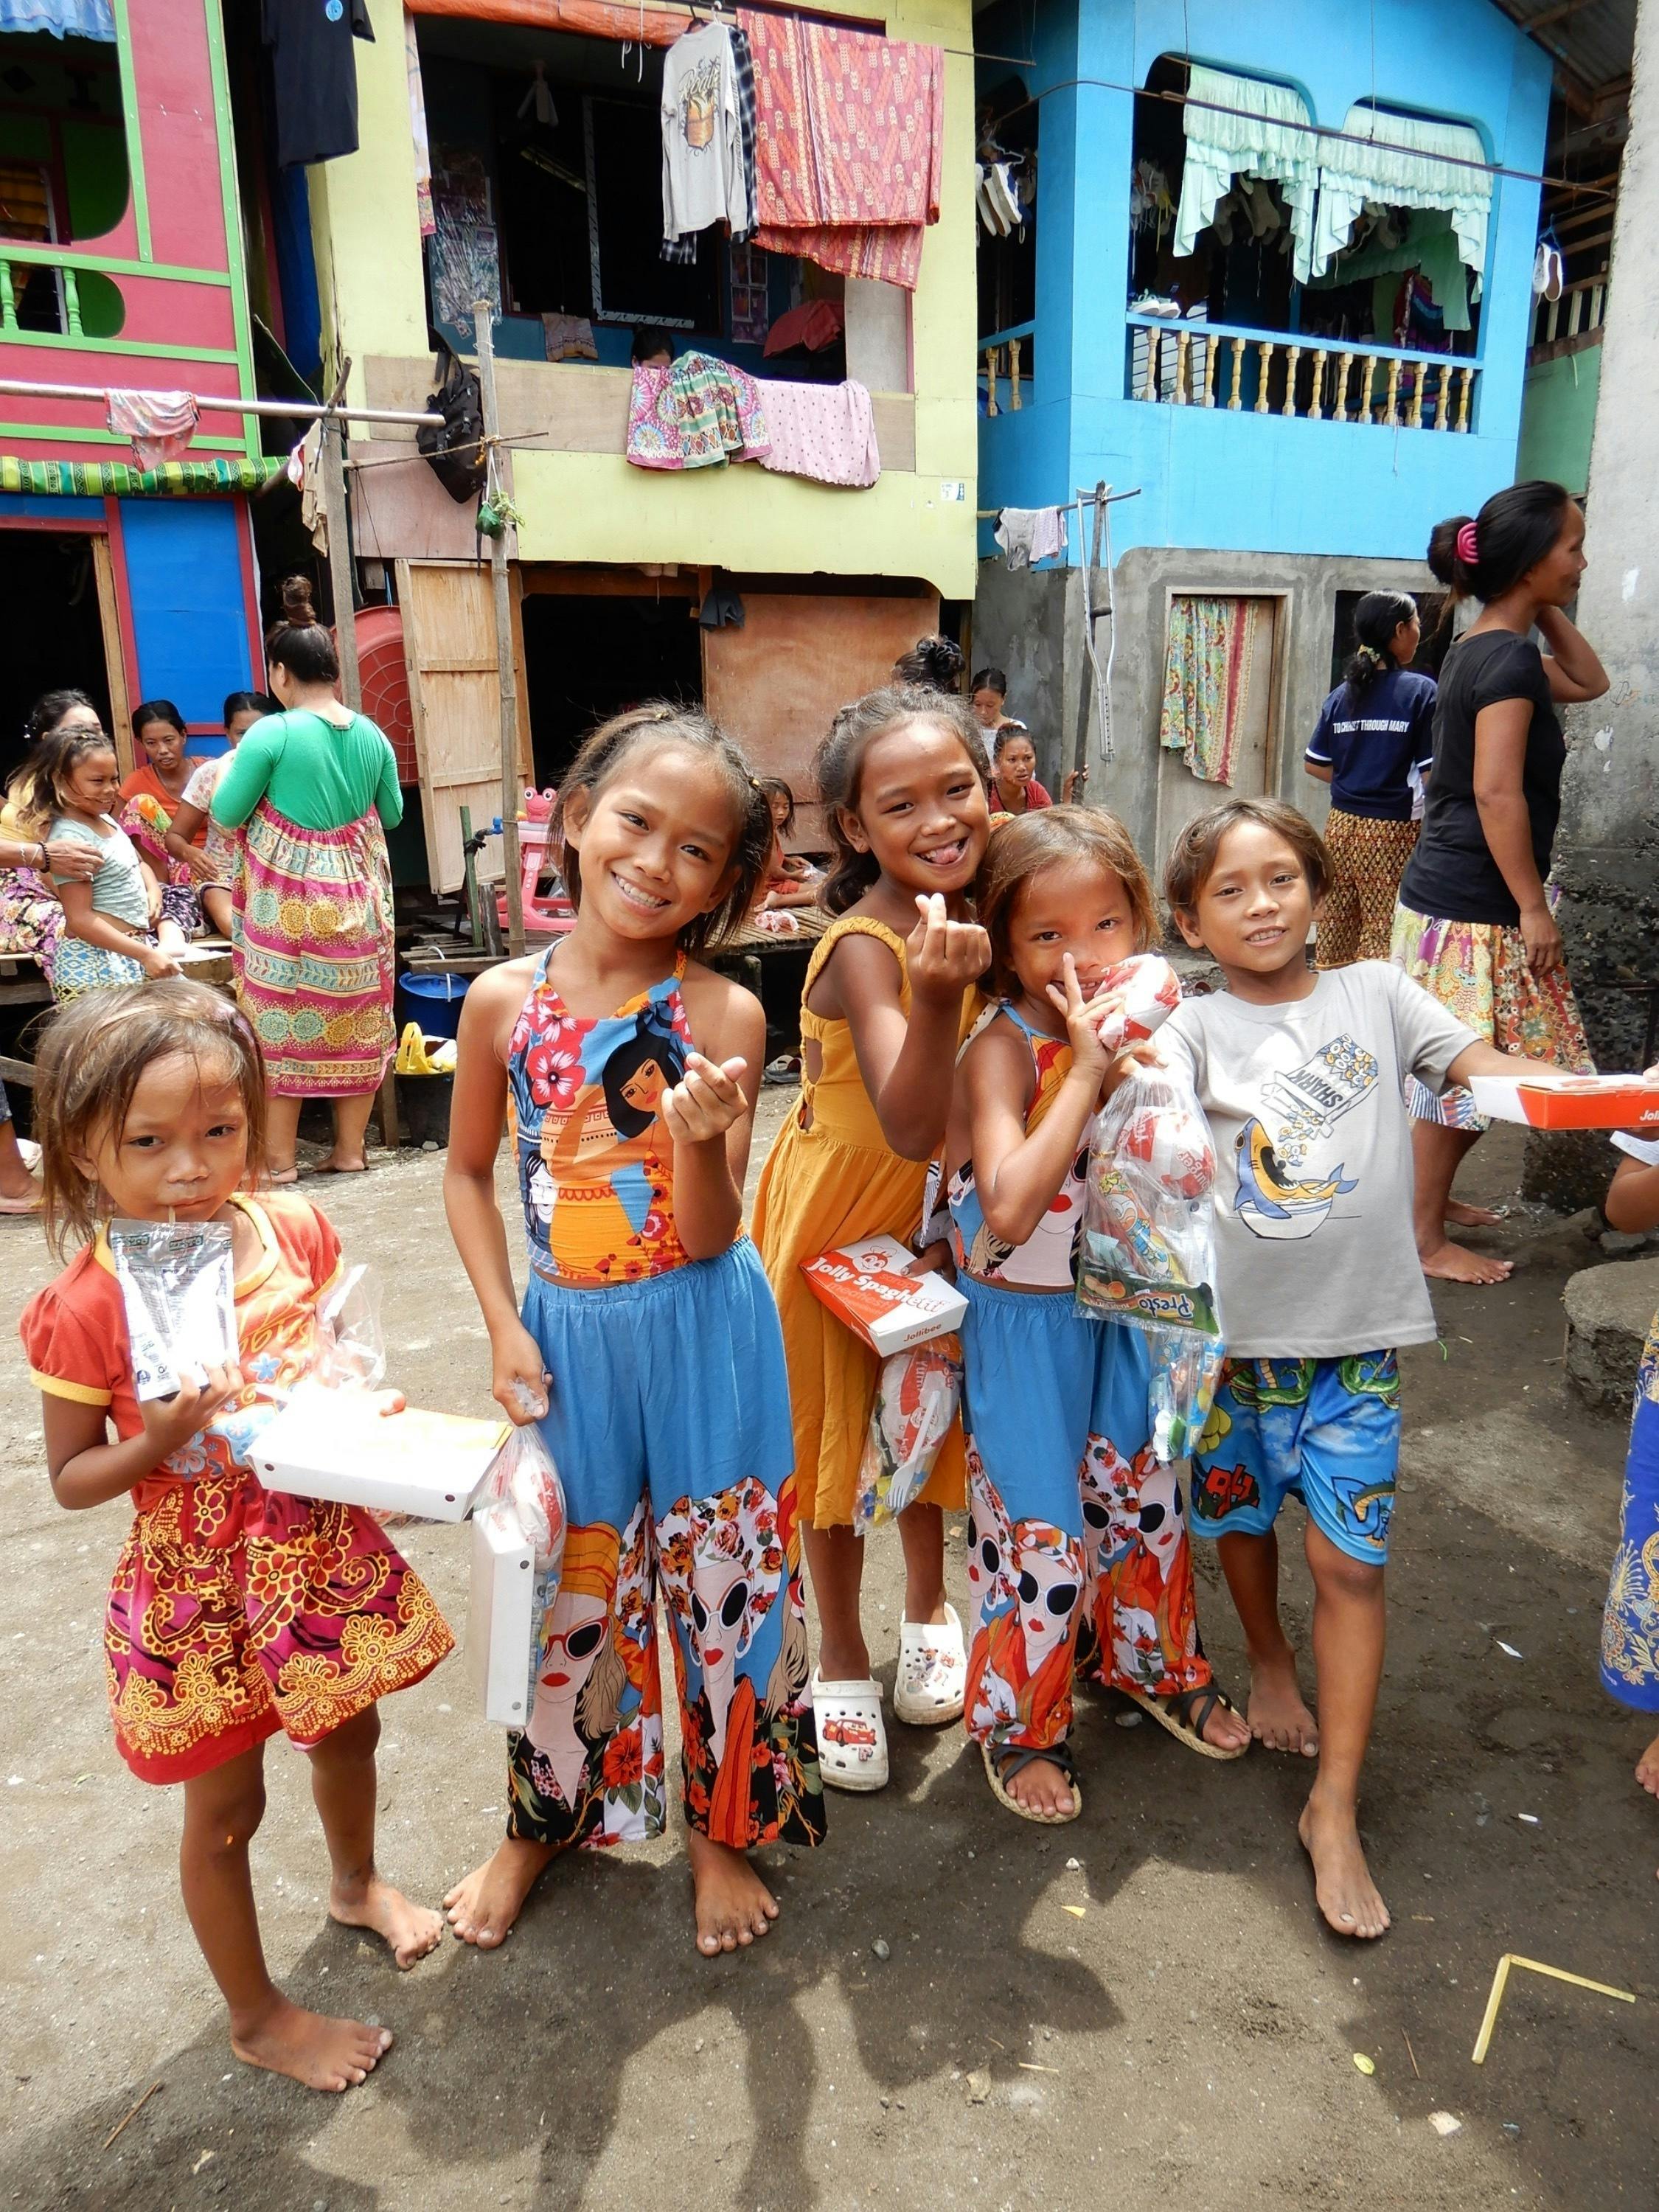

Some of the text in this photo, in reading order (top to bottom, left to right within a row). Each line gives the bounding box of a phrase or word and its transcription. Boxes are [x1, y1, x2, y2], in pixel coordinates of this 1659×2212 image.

[1333, 722, 1340, 734] TO
[1360, 719, 1388, 731] THROUGH
[1388, 720, 1410, 733] MARY
[1291, 1069, 1343, 1107] SHARK
[807, 1257, 851, 1283] Jolly
[853, 1275, 947, 1312] Spaghetti
[1138, 1293, 1194, 1319] Presto
[903, 1323, 942, 1342] Jollibee
